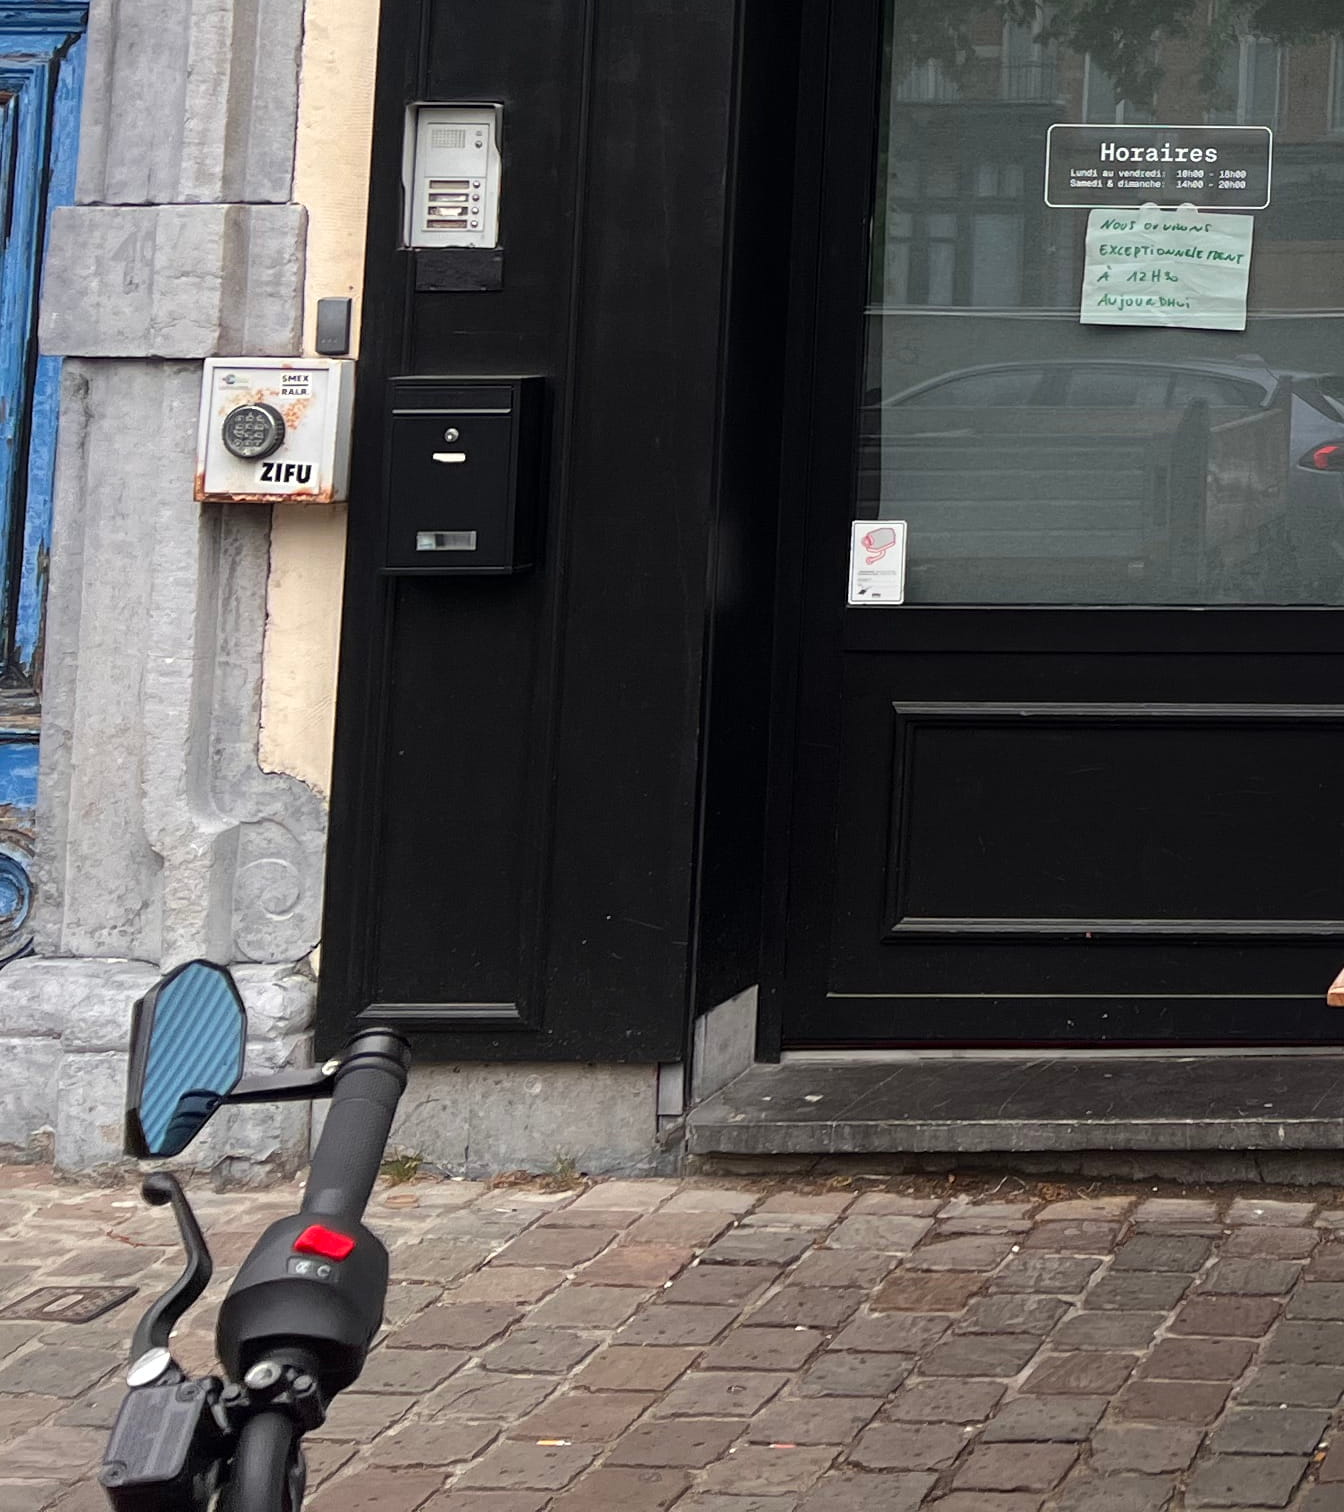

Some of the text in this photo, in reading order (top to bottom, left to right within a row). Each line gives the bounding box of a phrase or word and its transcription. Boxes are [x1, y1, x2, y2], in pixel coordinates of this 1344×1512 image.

[1100, 142, 1218, 163] Horaires
[1070, 169, 1098, 178] Lundi
[1118, 169, 1166, 179] vendredi:
[1070, 179, 1103, 188] Samedi
[1106, 179, 1114, 188] &
[1176, 180, 1204, 189] 14h00
[1218, 180, 1246, 190] 20h00
[1100, 219, 1136, 231] NOUS
[260, 462, 312, 484] ZIFU
